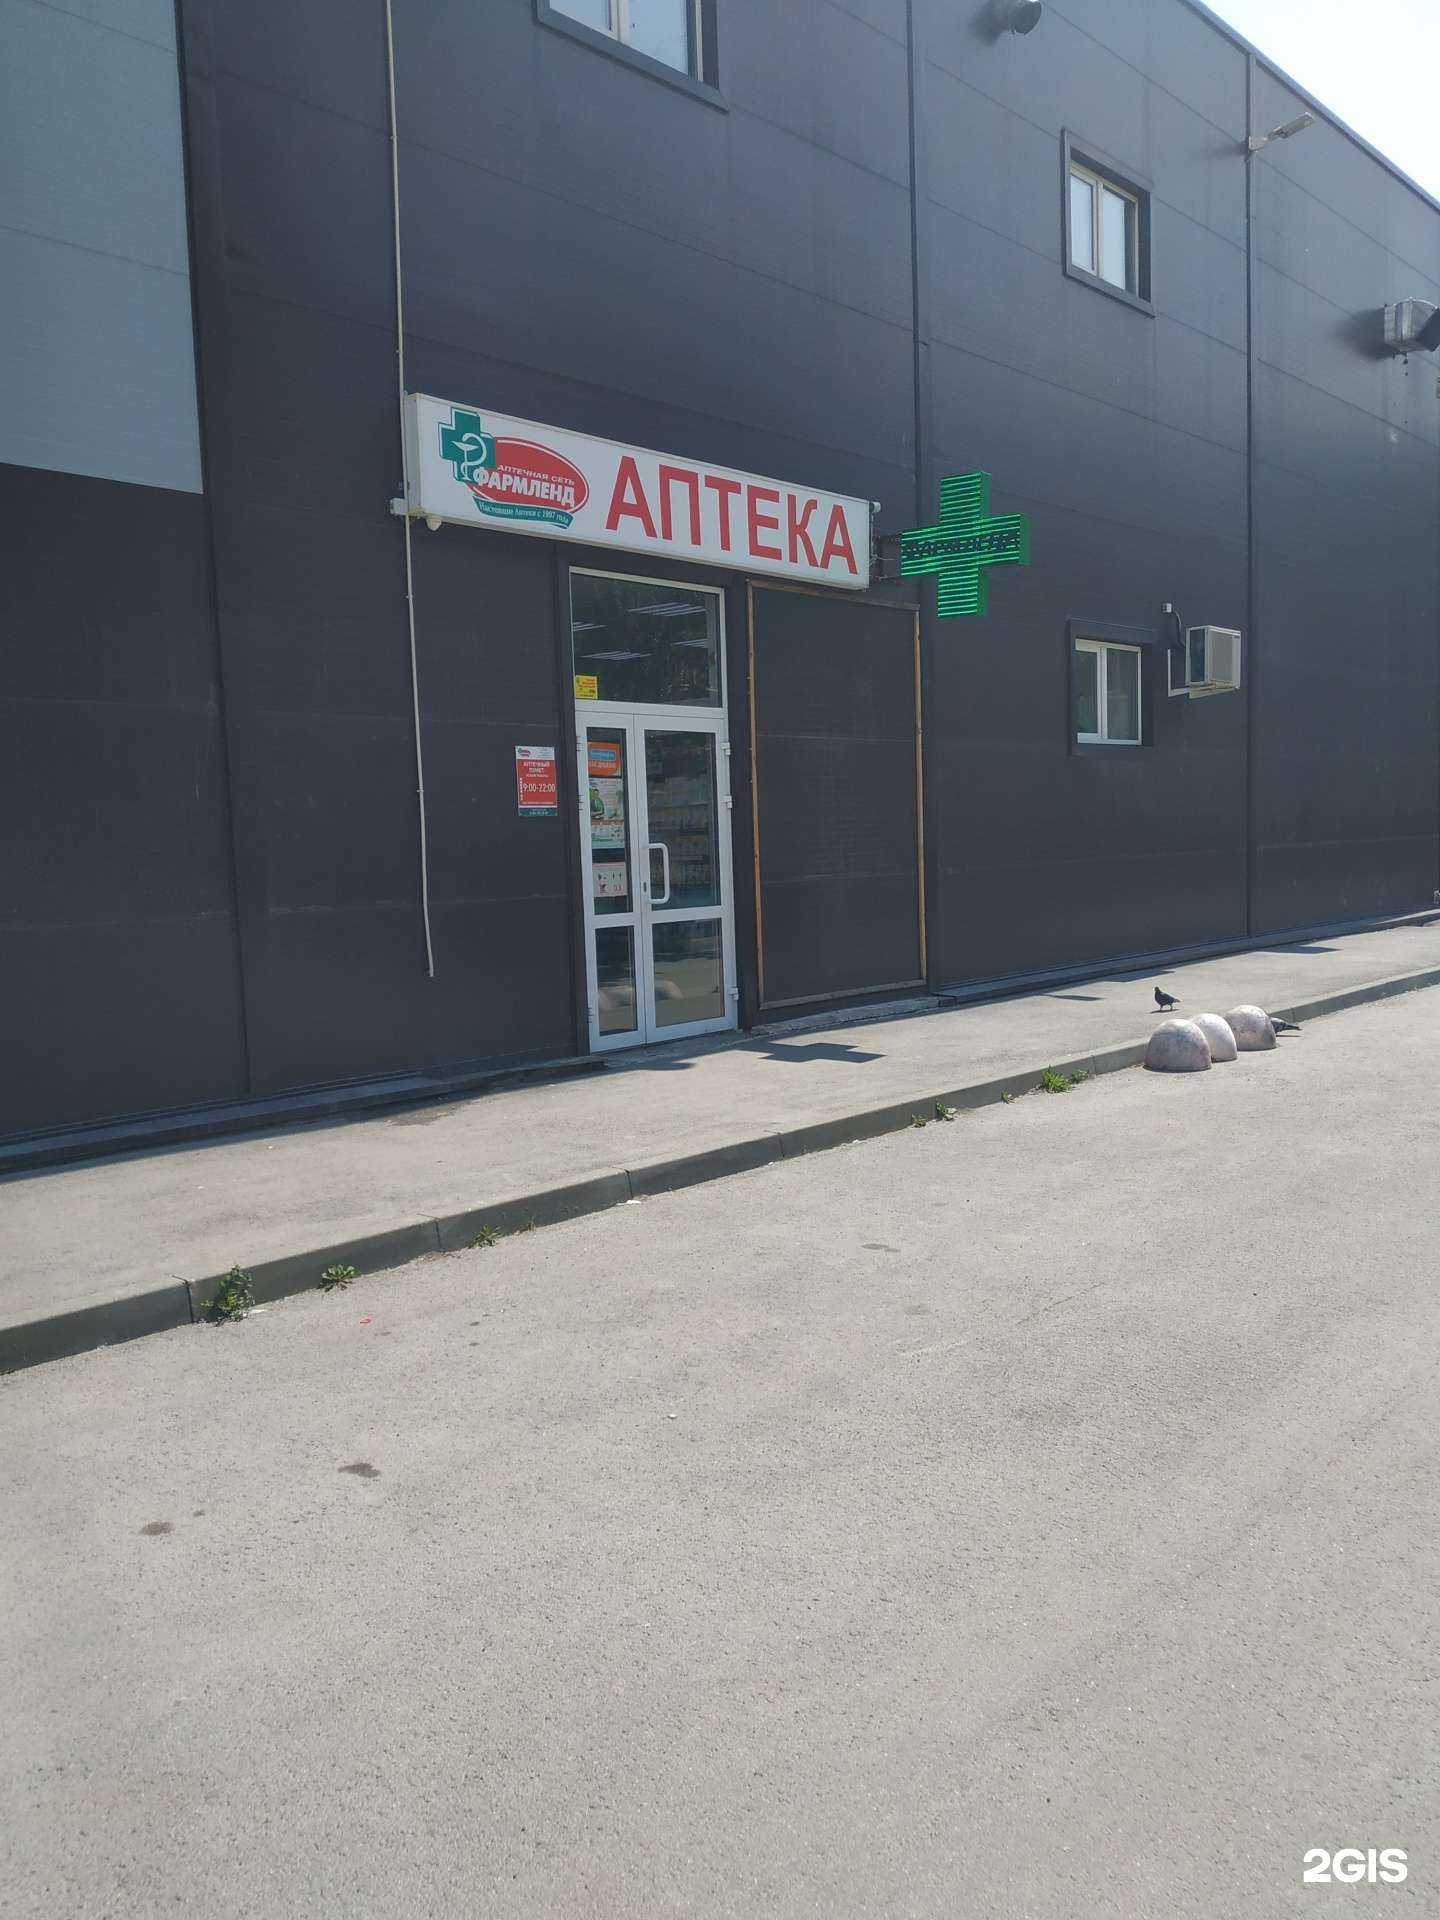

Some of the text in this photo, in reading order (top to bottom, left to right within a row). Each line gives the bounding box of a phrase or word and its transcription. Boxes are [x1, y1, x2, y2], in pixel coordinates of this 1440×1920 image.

[472, 466, 575, 508] ФАРМЛЕНД
[497, 464, 575, 486] АПТЕЧНАЯ СЕТЬ
[605, 455, 858, 575] АПТЕКА
